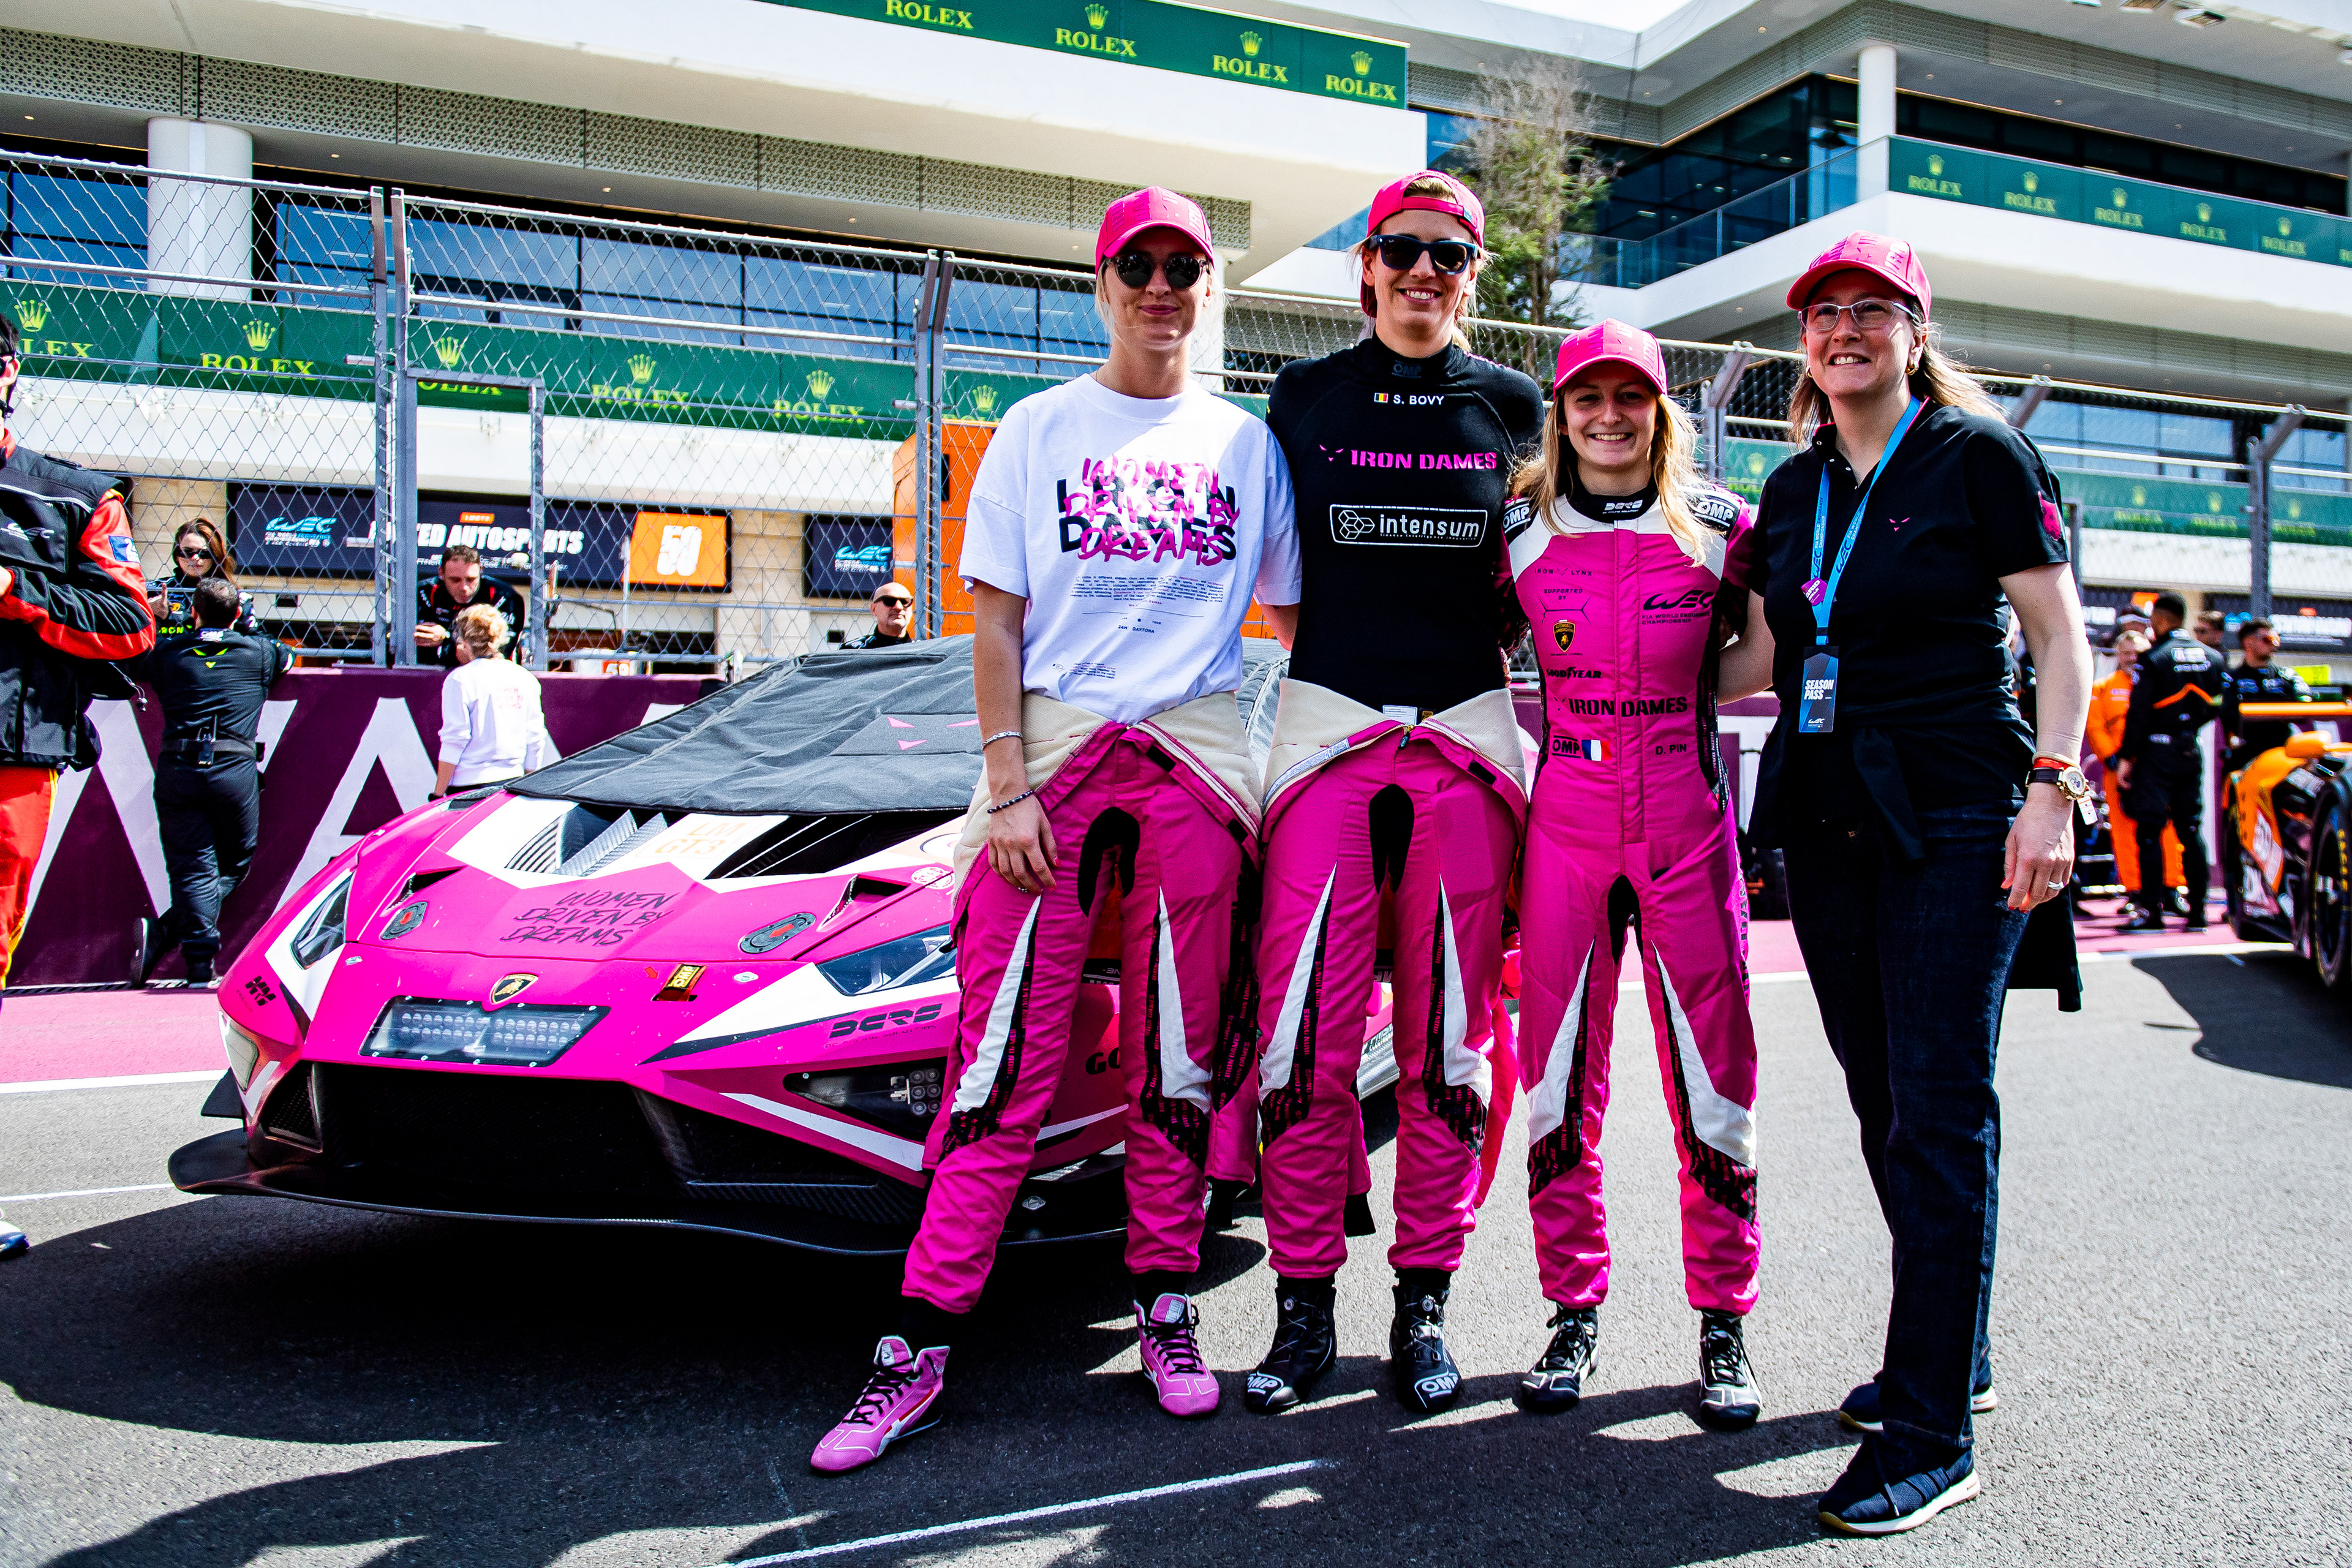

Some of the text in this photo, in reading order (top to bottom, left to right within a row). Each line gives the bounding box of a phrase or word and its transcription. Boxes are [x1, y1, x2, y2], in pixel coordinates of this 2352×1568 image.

[886, 0, 974, 30] ROLEX
[1055, 28, 1136, 58] ROLEX
[1212, 55, 1288, 83] ROLEX
[1325, 74, 1397, 101] ROLEX
[1908, 175, 1962, 196] ROLEX
[2003, 191, 2056, 214] ROLEX
[2094, 208, 2143, 227] ROLEX
[2180, 222, 2226, 241] ROLEX
[2261, 235, 2306, 255] ROLEX
[20, 338, 94, 359] LEX
[200, 353, 317, 381] ROLEX
[1393, 363, 1422, 376] OMP
[592, 383, 691, 410] ROLEX
[1393, 394, 1444, 405] S. BOVY
[772, 399, 865, 424] ROLEX
[1351, 450, 1497, 470] IRON DAMES
[1082, 453, 1218, 494] WOMEN
[1063, 489, 1240, 528] DRIVEN BY
[1503, 505, 1530, 529] OMP
[1698, 501, 1733, 520] OMP
[265, 516, 337, 533] WEC
[1379, 514, 1479, 537] intensum
[447, 524, 584, 554] AUTOSPRTS
[1077, 525, 1225, 567] DREAMS
[835, 545, 892, 560] WEC
[1836, 540, 1852, 573] WEC
[1643, 590, 1714, 610] WEC
[159, 626, 184, 635] RON
[1804, 679, 1834, 690] SEASON
[1804, 690, 1824, 699] PASS
[1568, 696, 1687, 718] IRON DAMES
[1552, 739, 1580, 755] OMP
[1656, 743, 1687, 755] D. PIN
[687, 822, 747, 836] LM
[655, 839, 726, 854] GT3
[556, 890, 680, 910] WOMEN
[513, 907, 639, 925] DRIVEN
[500, 925, 633, 947] DREAMS
[673, 966, 695, 987] OMP
